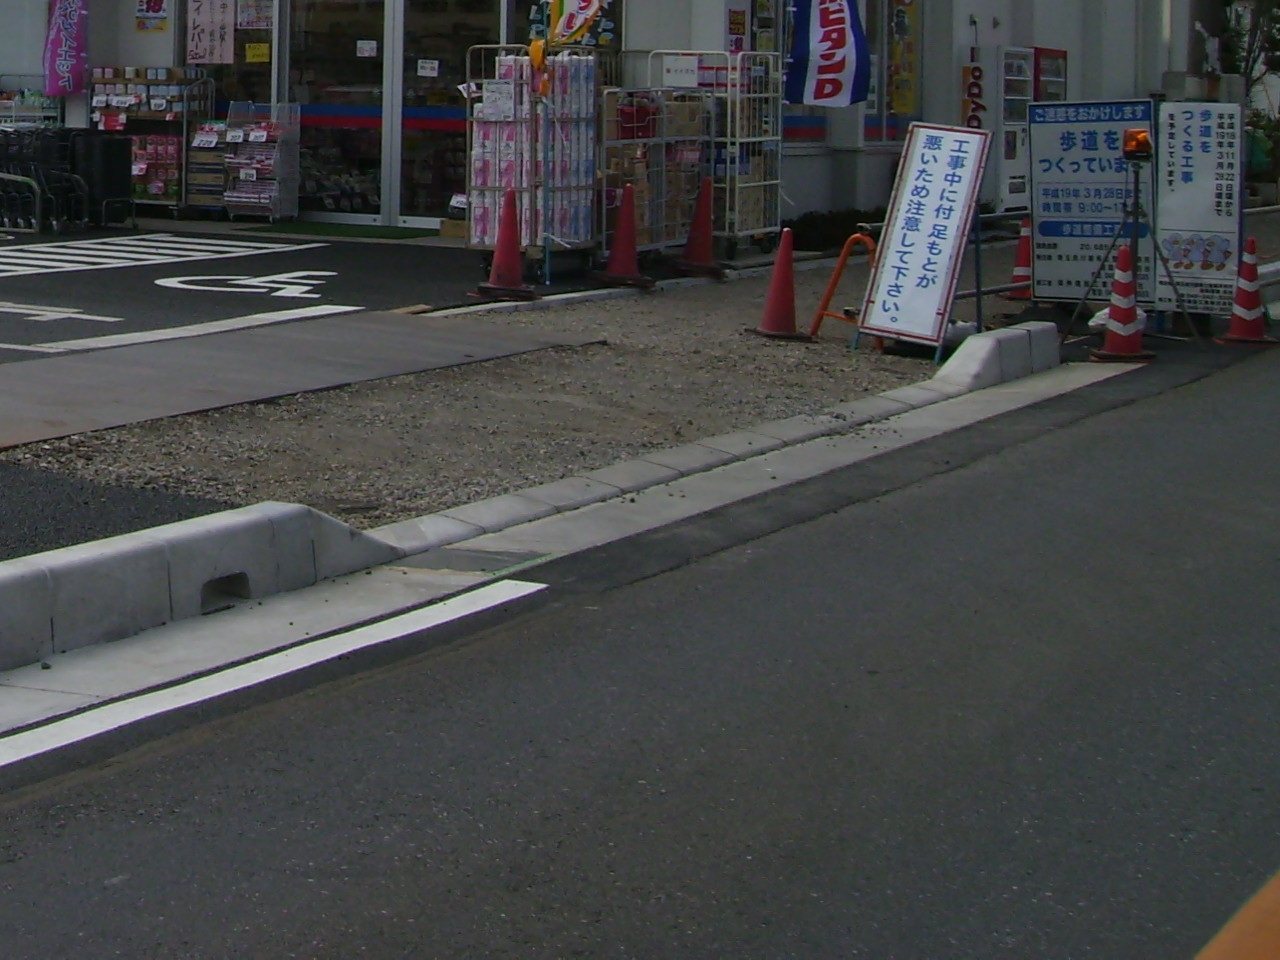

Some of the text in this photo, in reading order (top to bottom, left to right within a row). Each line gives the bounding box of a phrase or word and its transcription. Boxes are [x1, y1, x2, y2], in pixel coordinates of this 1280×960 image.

[967, 66, 987, 129] DyDo
[1060, 130, 1120, 152] 歩道を
[1180, 110, 1194, 184] つくる工事
[1199, 109, 1213, 153] 歩道を
[1039, 156, 1135, 173] つくっていま
[882, 134, 944, 324] 悪いため注意して下さい。
